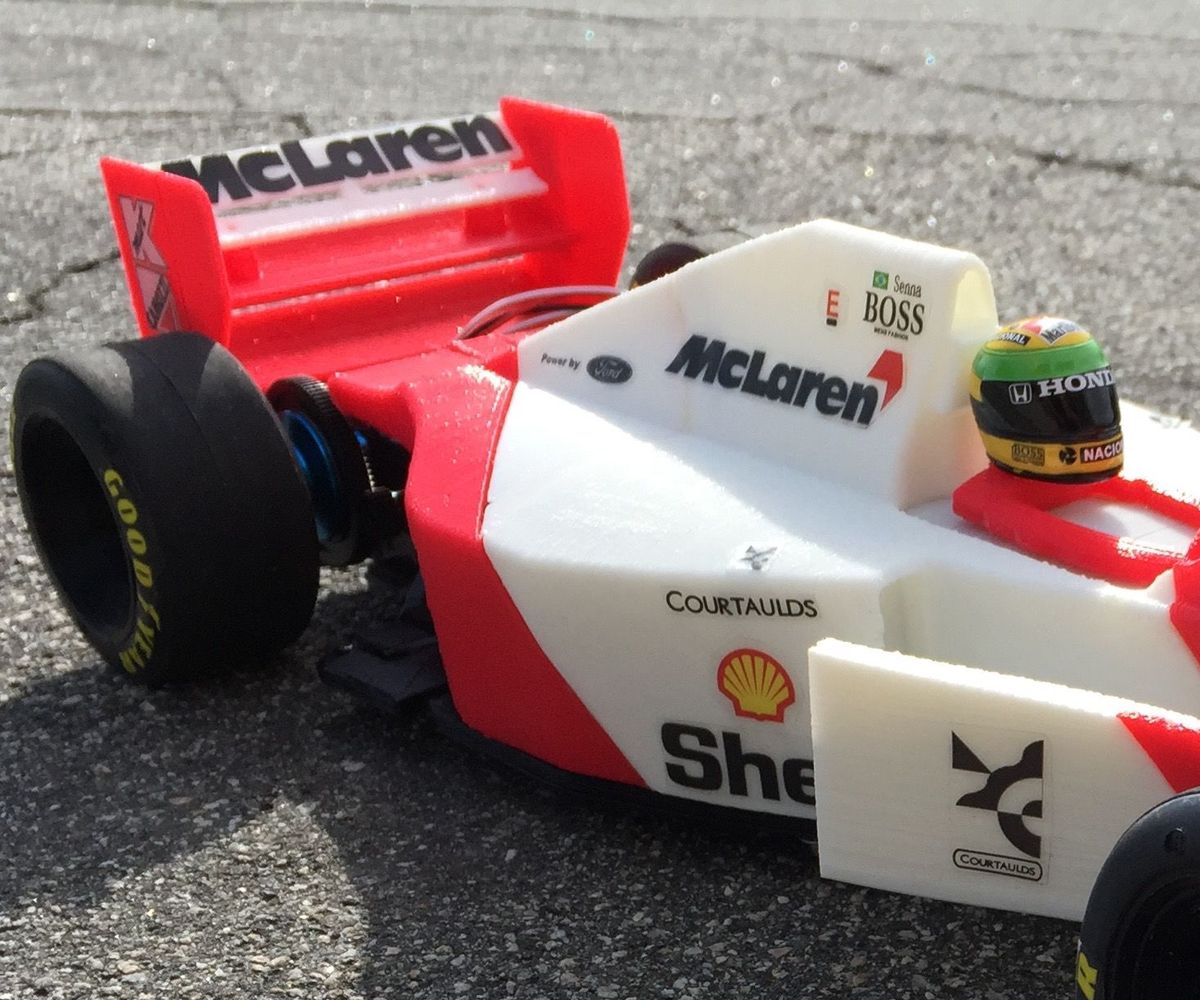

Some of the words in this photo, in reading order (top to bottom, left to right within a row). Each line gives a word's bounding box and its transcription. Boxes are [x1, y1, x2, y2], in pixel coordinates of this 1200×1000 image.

[162, 115, 512, 203] McLaren
[893, 275, 922, 298] Senna
[863, 291, 925, 335] BOSS
[569, 357, 581, 370] by
[665, 334, 880, 426] McLaren
[1084, 440, 1122, 461] NACIO
